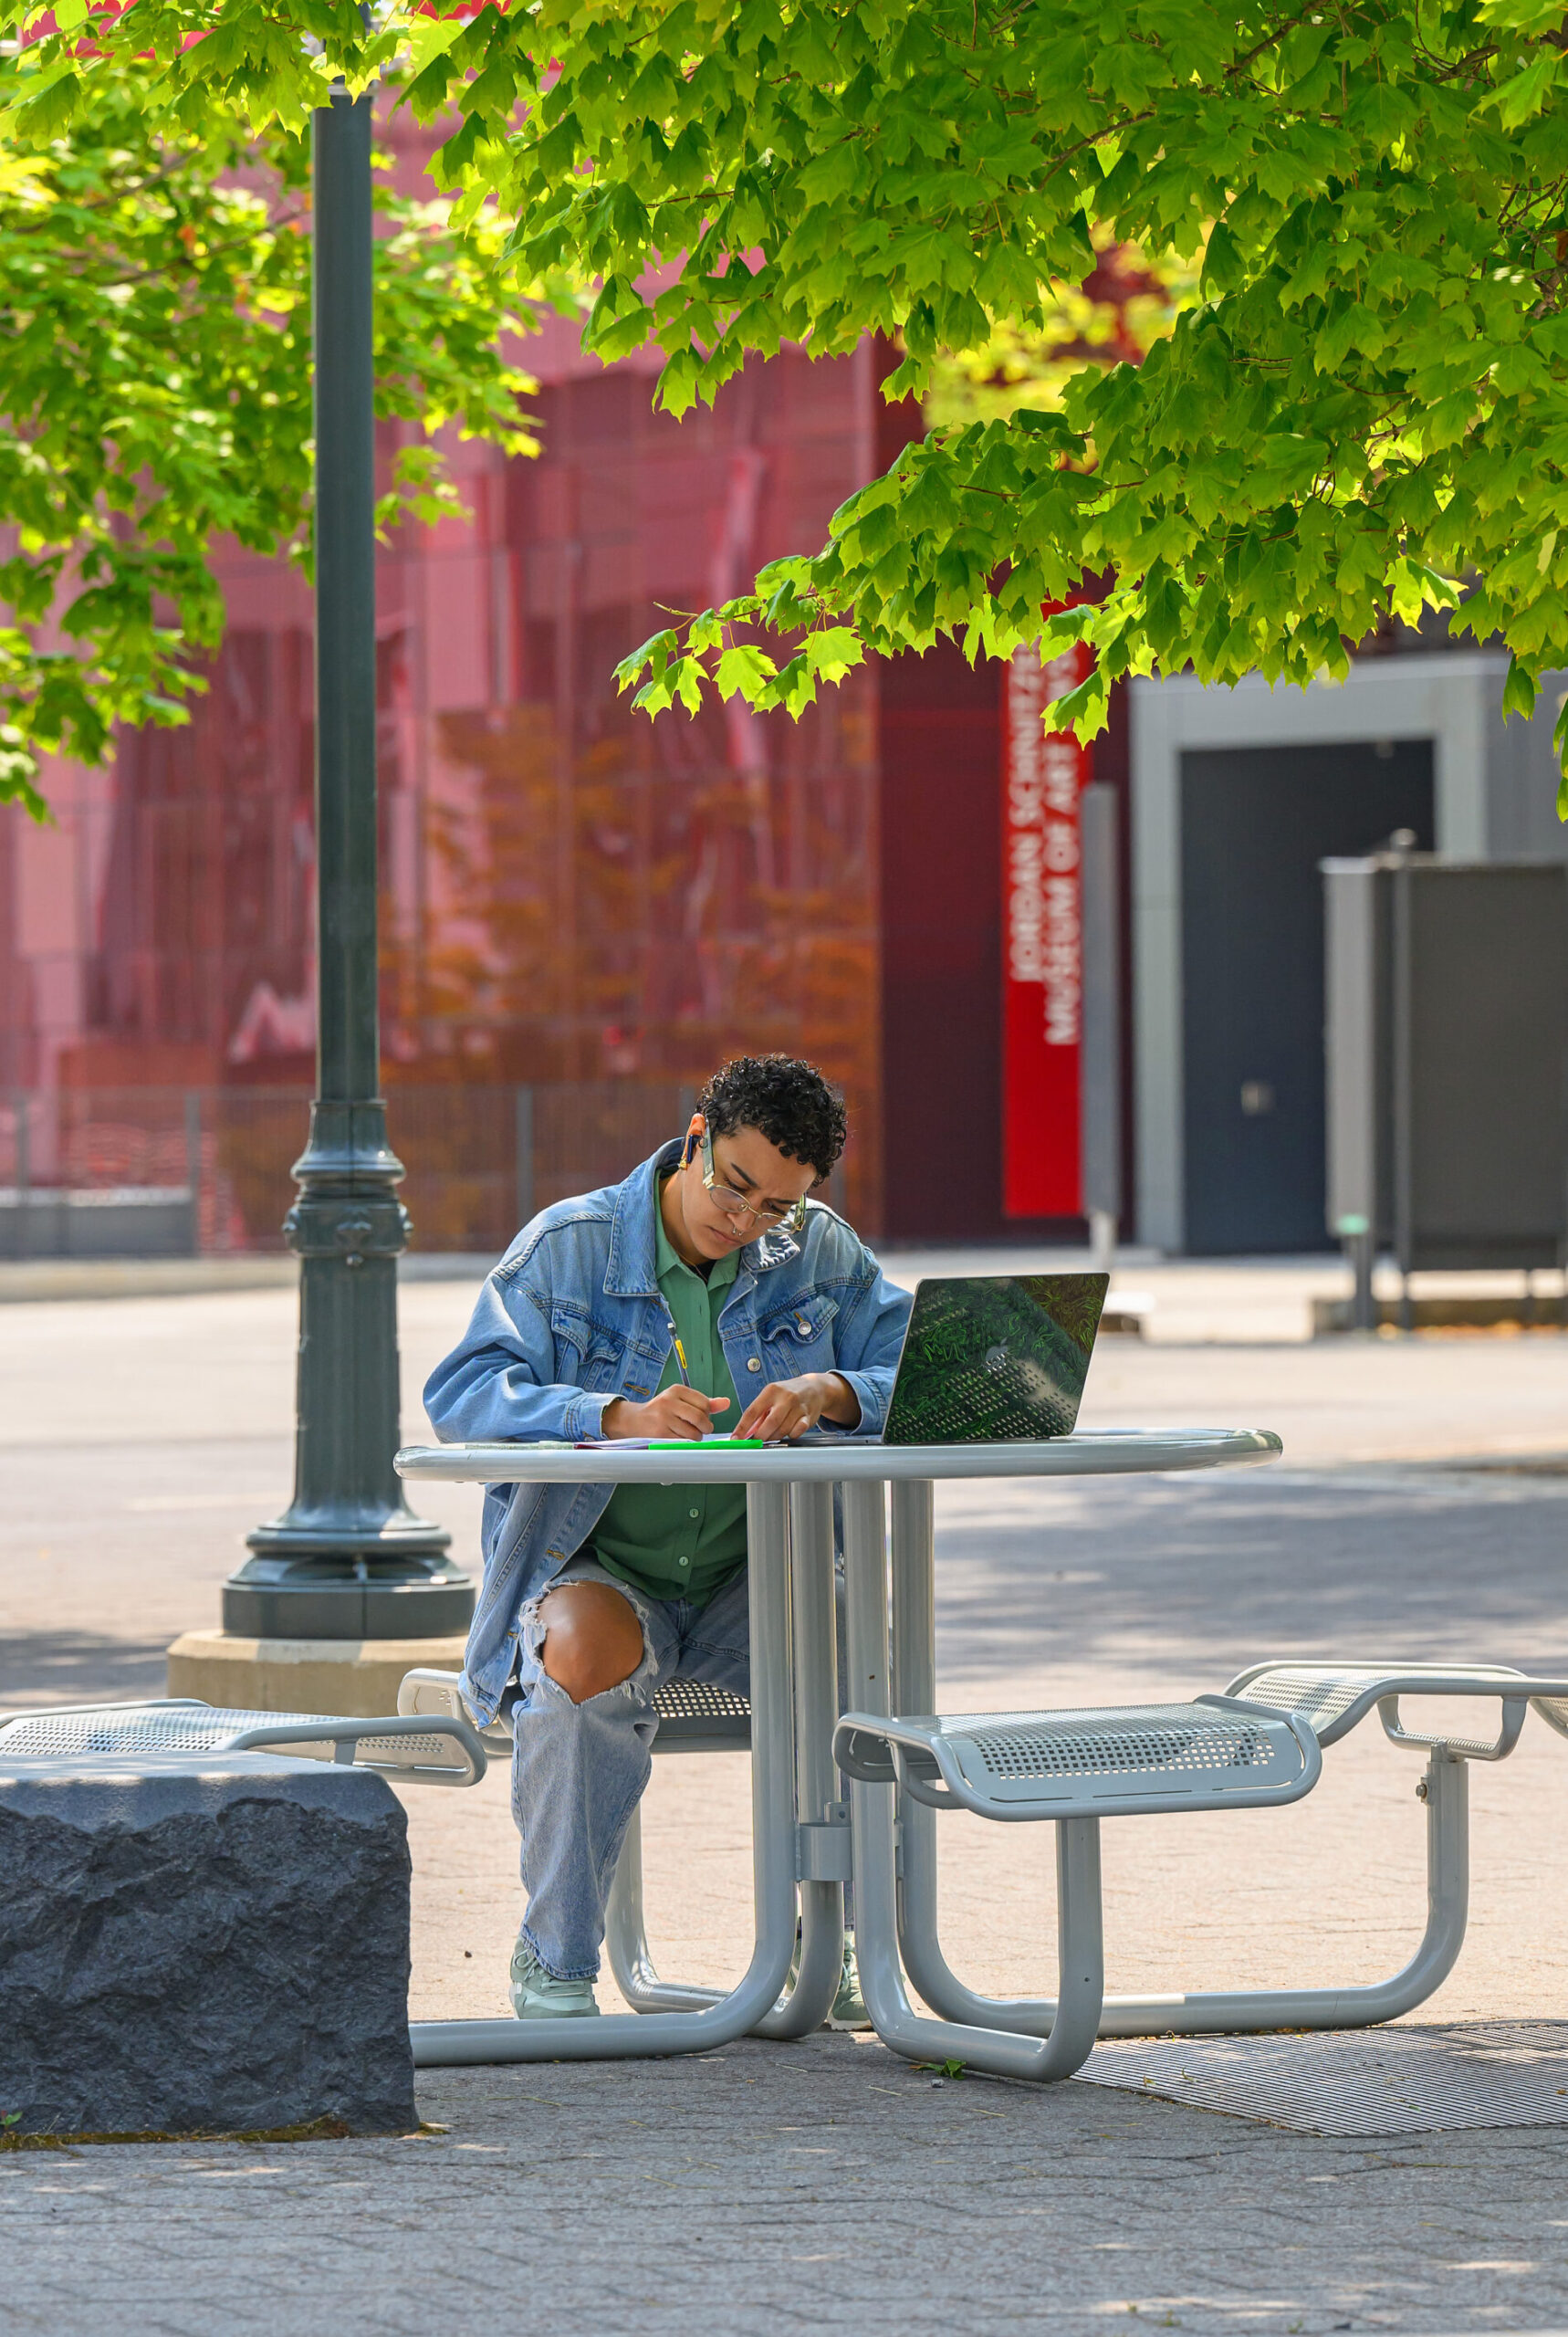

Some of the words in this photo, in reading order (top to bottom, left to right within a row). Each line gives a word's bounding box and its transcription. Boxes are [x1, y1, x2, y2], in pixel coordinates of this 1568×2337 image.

[1042, 743, 1079, 815] ART
[1042, 823, 1080, 874] OF
[1009, 833, 1044, 982] JORDAN
[1043, 875, 1081, 1045] MUSEUM
